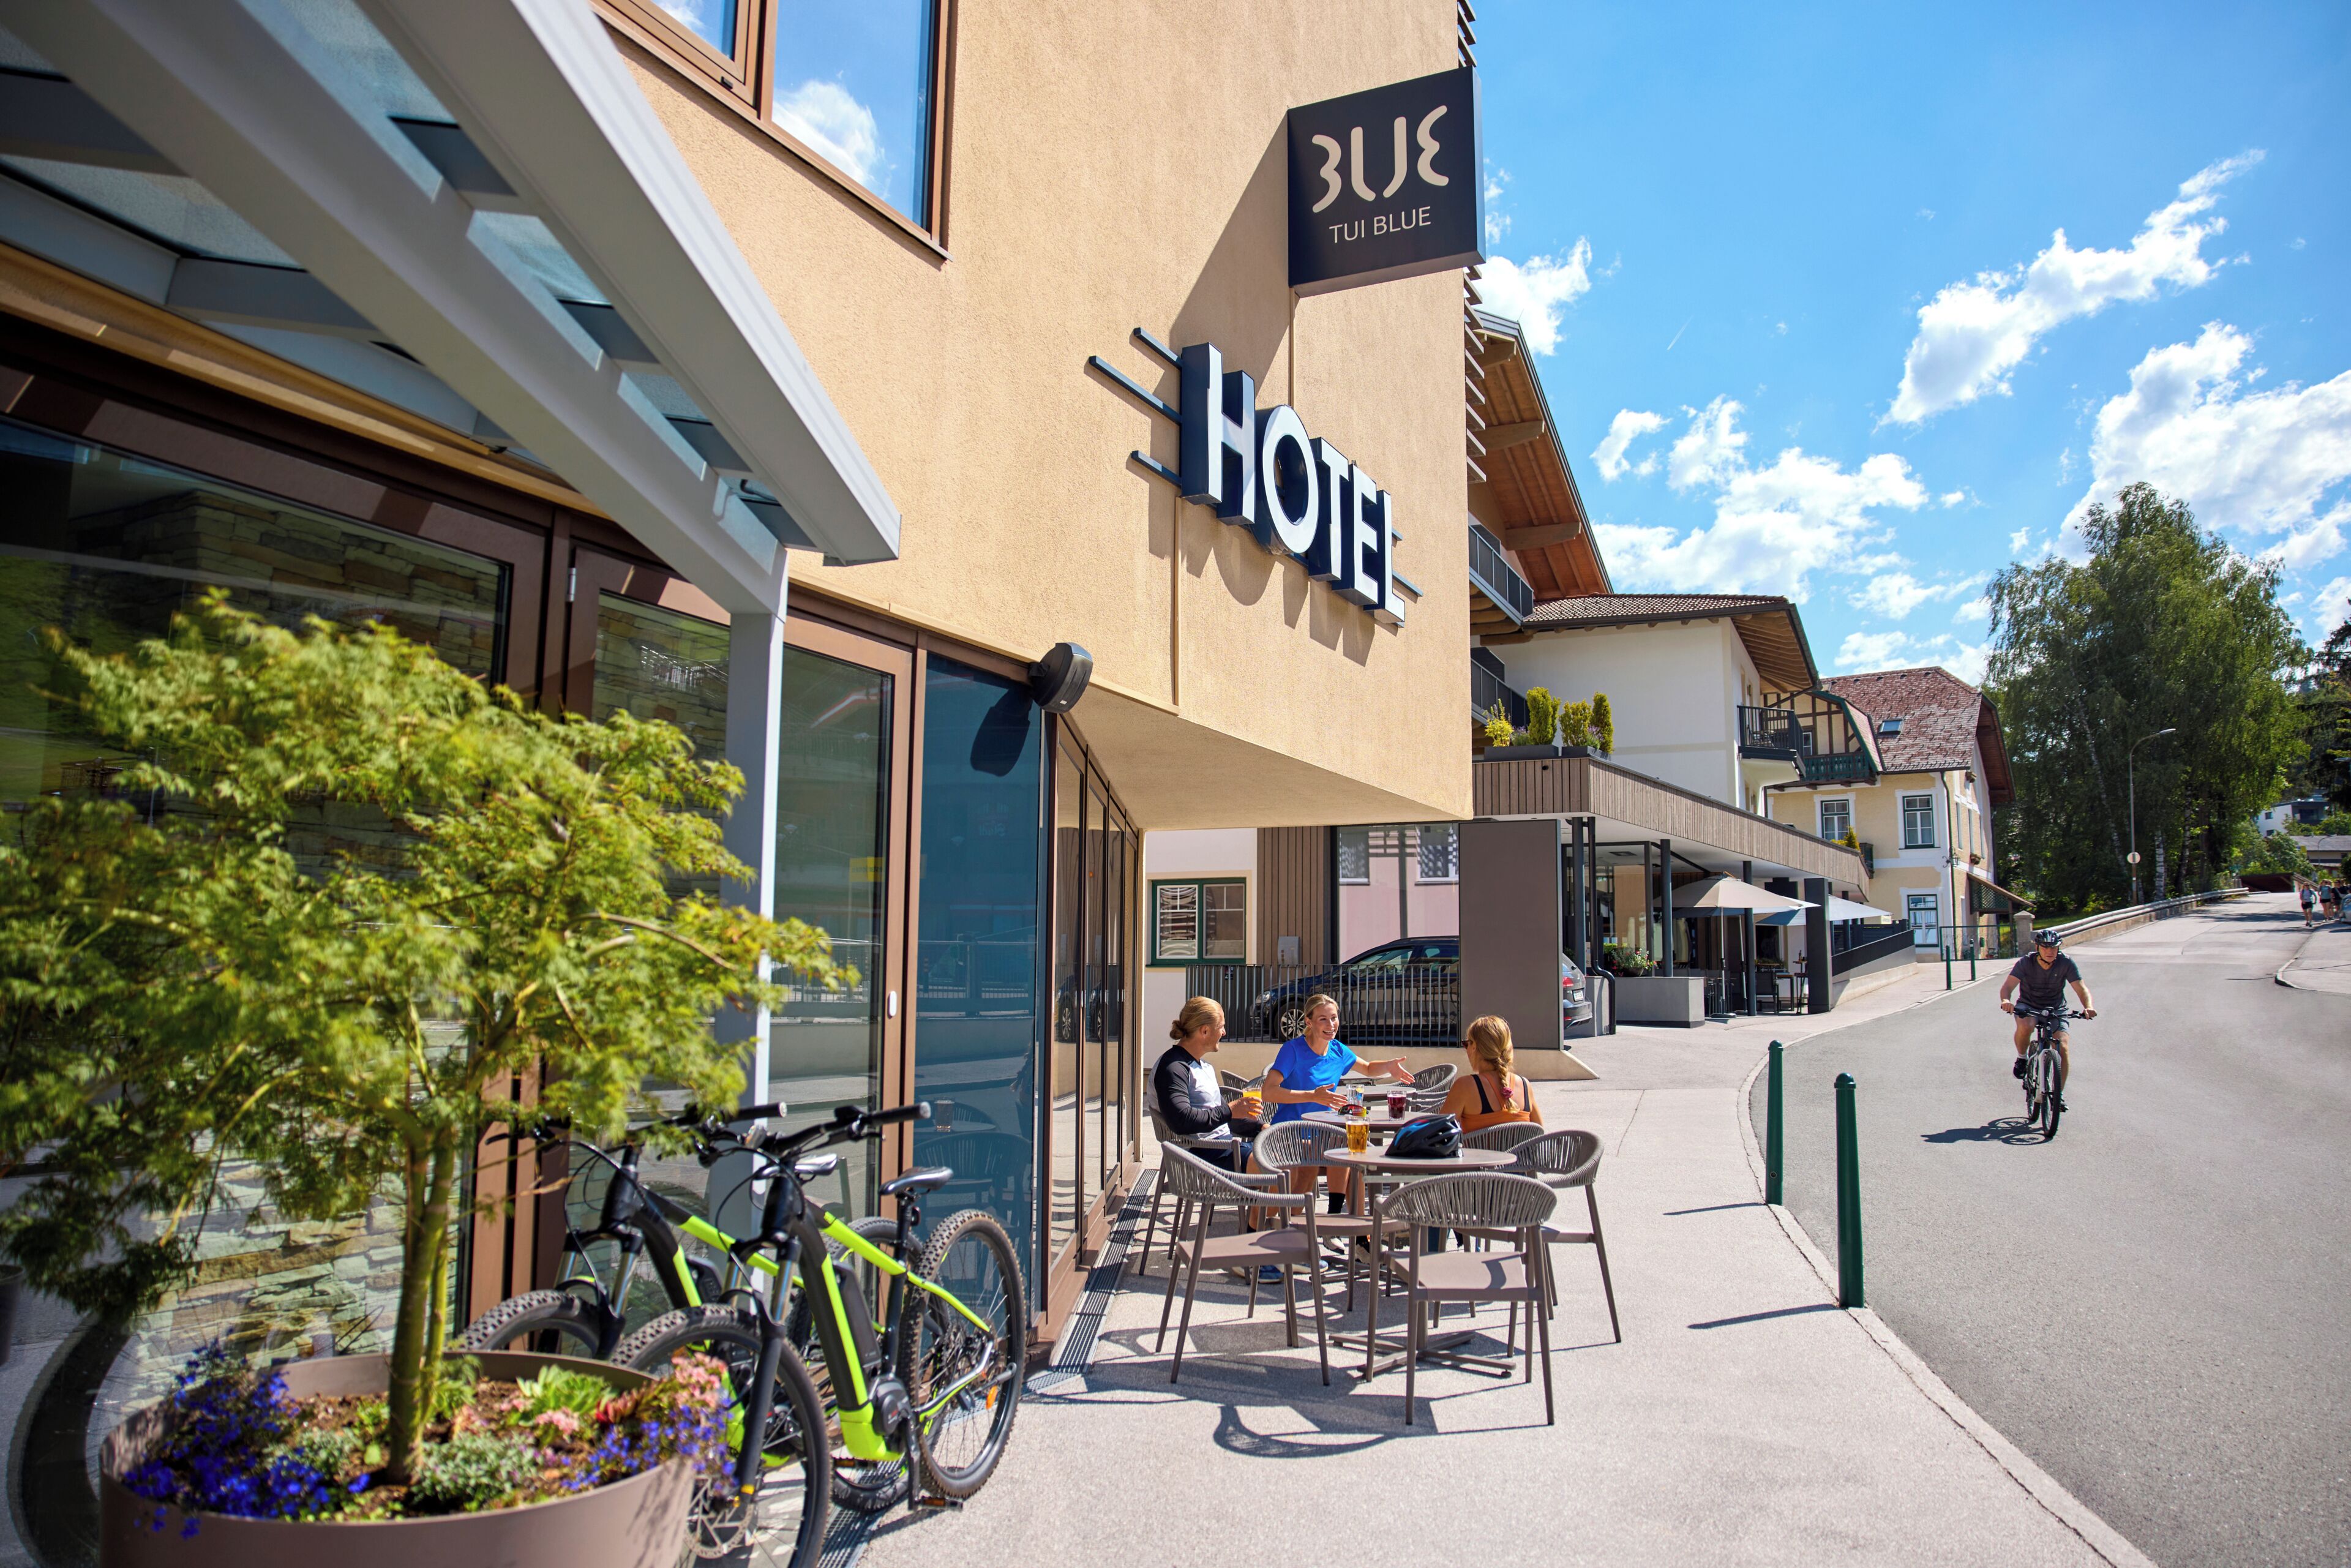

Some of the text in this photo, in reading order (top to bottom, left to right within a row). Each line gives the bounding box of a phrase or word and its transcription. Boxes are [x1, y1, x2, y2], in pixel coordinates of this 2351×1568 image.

[1329, 206, 1431, 244] TUI BLUE
[1181, 341, 1406, 624] HOTEL
